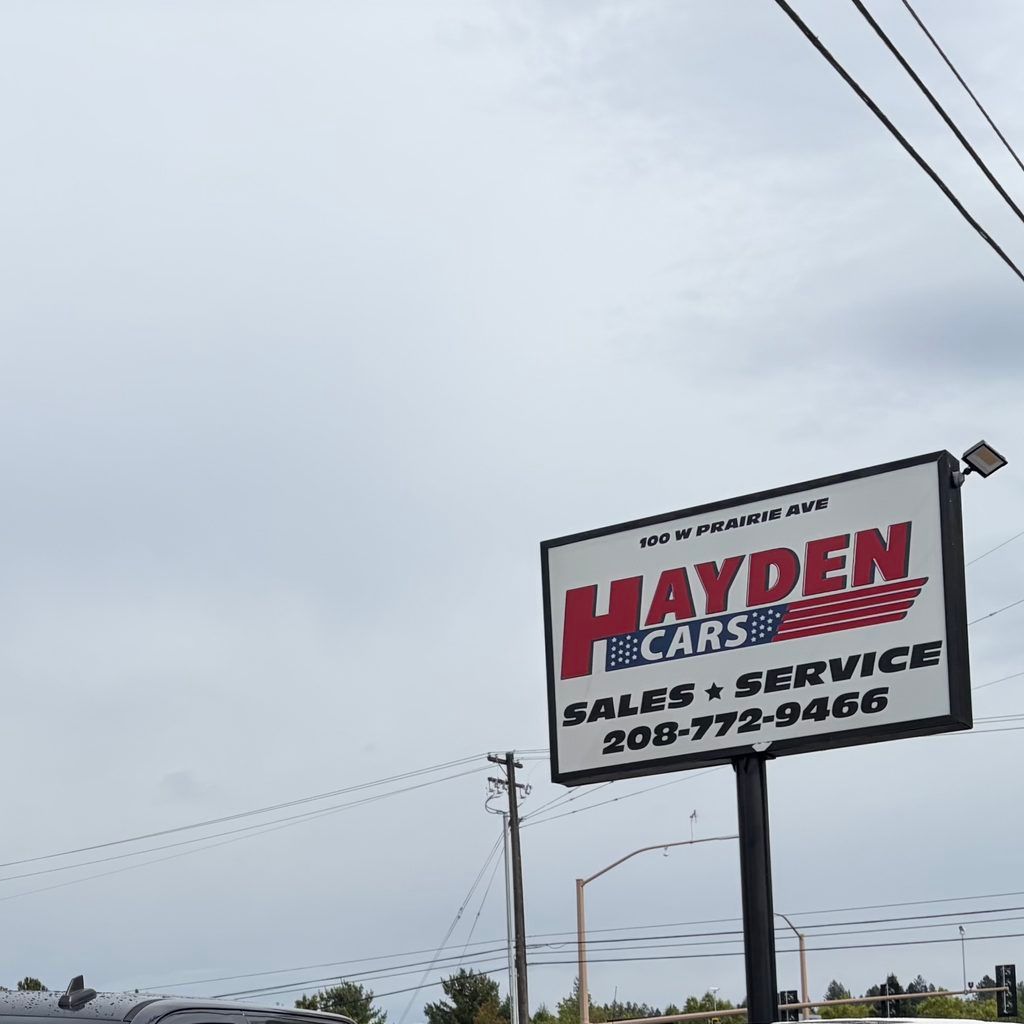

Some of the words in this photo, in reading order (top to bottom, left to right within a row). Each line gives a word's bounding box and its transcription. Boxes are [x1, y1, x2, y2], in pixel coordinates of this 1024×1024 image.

[639, 532, 671, 549] 100
[675, 527, 693, 541] W
[696, 508, 782, 537] PRAIRIE
[785, 497, 830, 517] AVE
[560, 521, 913, 680] HAYDEN
[639, 614, 749, 661] CARS
[562, 682, 696, 727] SALES
[734, 640, 943, 698] SERVICE
[601, 687, 890, 755] 208-772-9466
